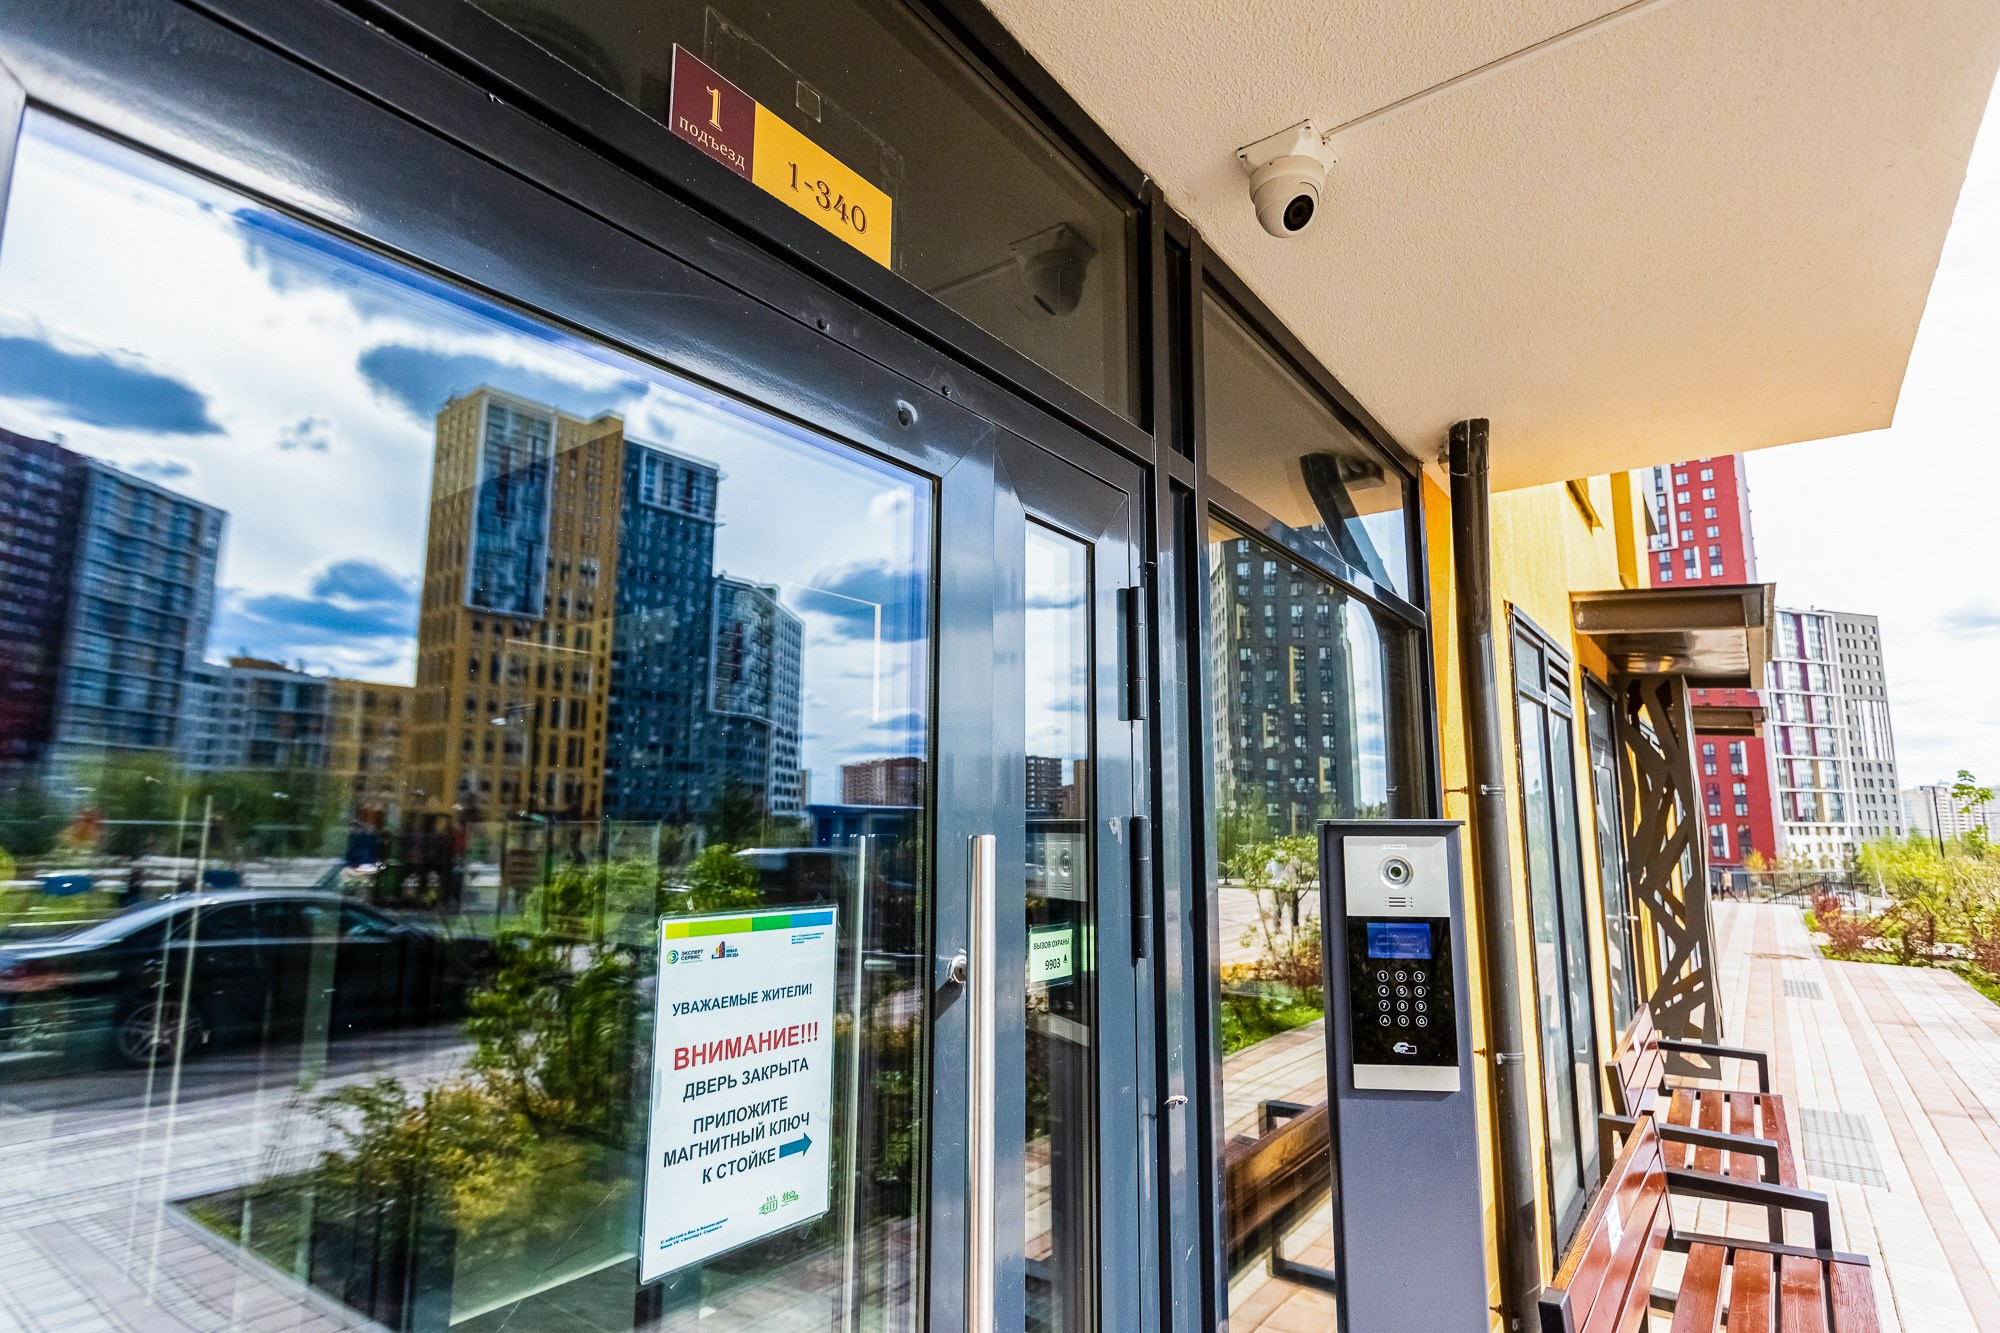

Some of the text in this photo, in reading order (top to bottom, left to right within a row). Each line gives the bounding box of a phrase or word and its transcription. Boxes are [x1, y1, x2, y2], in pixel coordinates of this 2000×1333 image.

[706, 85, 723, 132] 1
[679, 116, 745, 171] подъезд
[788, 161, 867, 234] 1-340
[1033, 938, 1070, 950] ВЫЗОВ ОХРАНЫ
[1044, 957, 1061, 971] 9903
[672, 983, 813, 1017] УВАЖАЕМЫЕ ЖИТЕЛИ!
[674, 1021, 819, 1071] ВНИМАНИЕ!!!
[683, 1057, 809, 1102] ДВЕРЬ ЗАКРЫТА
[693, 1096, 788, 1135] ПРИЛОЖИТЕ
[663, 1112, 810, 1168] МАГНИТНЫЙ КЛЮЧ
[702, 1147, 776, 1185] К СТОЙКЕ
